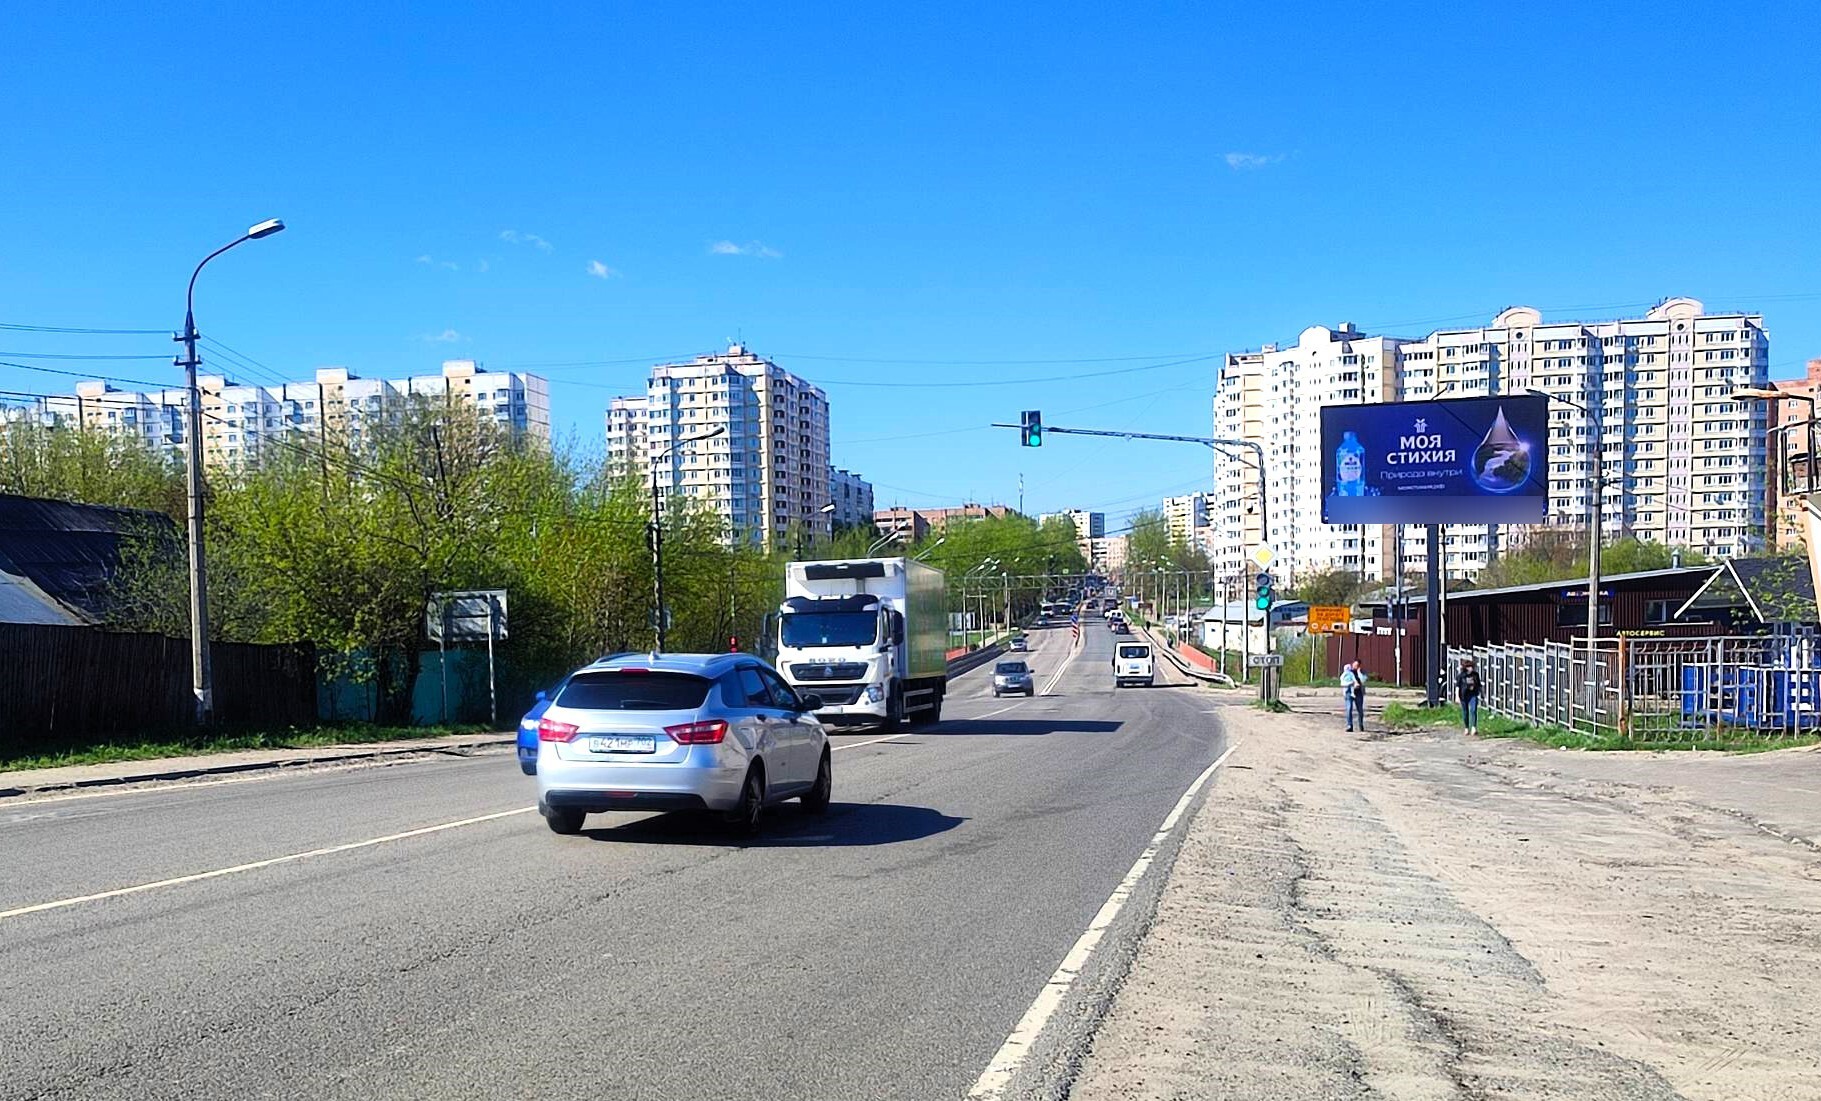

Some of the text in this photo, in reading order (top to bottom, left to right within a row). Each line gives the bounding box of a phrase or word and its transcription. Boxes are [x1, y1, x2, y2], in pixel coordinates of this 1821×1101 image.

[1400, 435, 1441, 449] МОЯ
[1386, 449, 1456, 465] СТИХИЯ
[1253, 655, 1280, 665] СТОП
